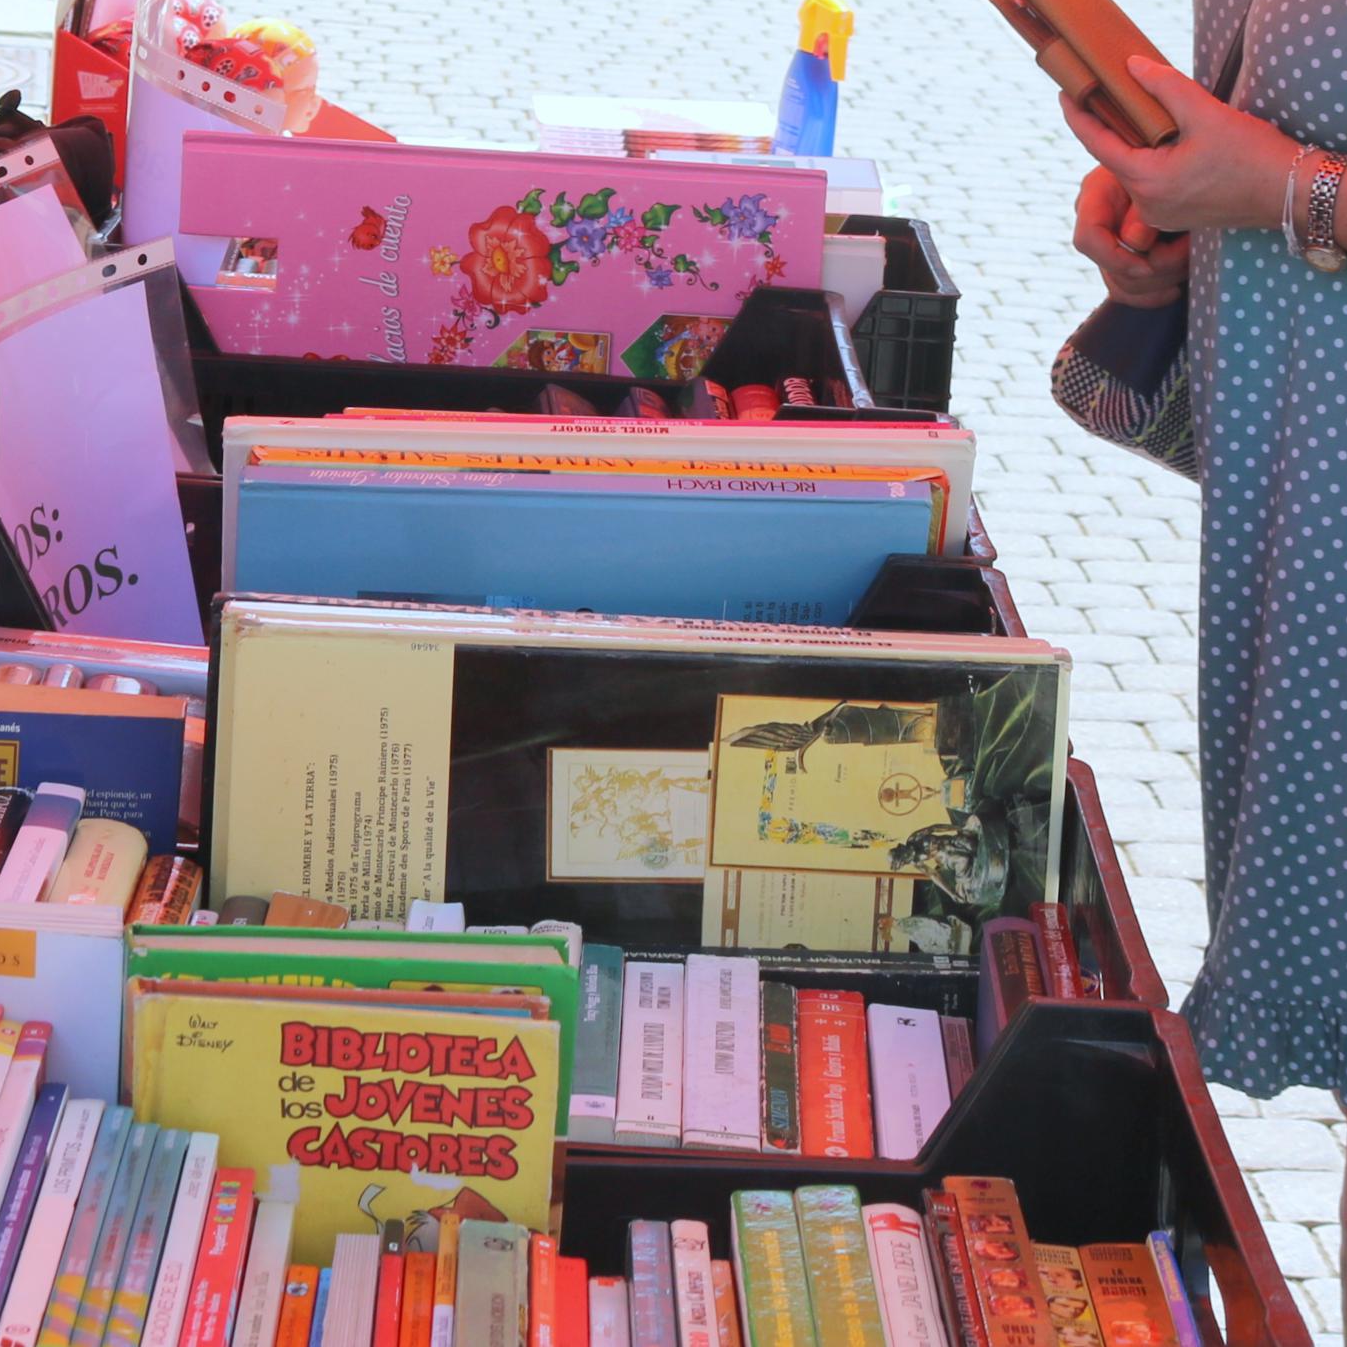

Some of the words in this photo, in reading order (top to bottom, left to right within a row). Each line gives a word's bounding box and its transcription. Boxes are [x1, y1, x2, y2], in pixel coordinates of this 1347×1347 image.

[358, 272, 398, 296] de
[379, 195, 412, 261] cuento
[550, 425, 616, 433] STROGOFF
[621, 426, 669, 434] MIGUEL
[380, 470, 457, 486] Salvador
[667, 478, 721, 491] BACH
[728, 479, 816, 493] RICHARD
[380, 707, 389, 739] (1975)
[328, 754, 338, 786] (1975)
[378, 742, 387, 783] Rainiero
[390, 743, 400, 775] (1976)
[403, 743, 412, 776] (1977)
[85, 799, 108, 808] hasta
[110, 800, 127, 809] que
[96, 790, 138, 801] espionaje,
[140, 792, 152, 800] un
[389, 778, 399, 833] Montecarlo
[426, 800, 434, 809] la
[100, 810, 121, 819] Pero,
[123, 812, 143, 820] para
[304, 813, 314, 827] LA
[326, 789, 337, 855] Audiovisuales
[351, 791, 362, 858] Teleprograma
[401, 805, 410, 818] de
[426, 812, 434, 824] de
[364, 815, 372, 847] (1974)
[388, 836, 396, 847] de
[399, 818, 410, 851] Sports
[424, 826, 434, 860] qualité
[303, 839, 313, 885] HOMBRE
[351, 862, 358, 873] de
[375, 829, 385, 884] Montecarlo
[387, 850, 396, 887] Festival
[399, 854, 407, 870] des
[424, 862, 432, 872] la
[325, 859, 334, 892] Medios
[337, 871, 346, 902] (1976)
[350, 876, 358, 900] 1975
[362, 879, 370, 891] de
[361, 895, 369, 919] Perla
[375, 887, 382, 898] de
[280, 1021, 536, 1082] BIBLIOTECA
[278, 1071, 316, 1093] de
[280, 1099, 323, 1119] los
[323, 1076, 534, 1130] JOVENES
[770, 1086, 789, 1129] SIMENON
[287, 1122, 519, 1180] CASTORES
[890, 1239, 913, 1272] DEFOE
[901, 1273, 918, 1310] DANIEL
